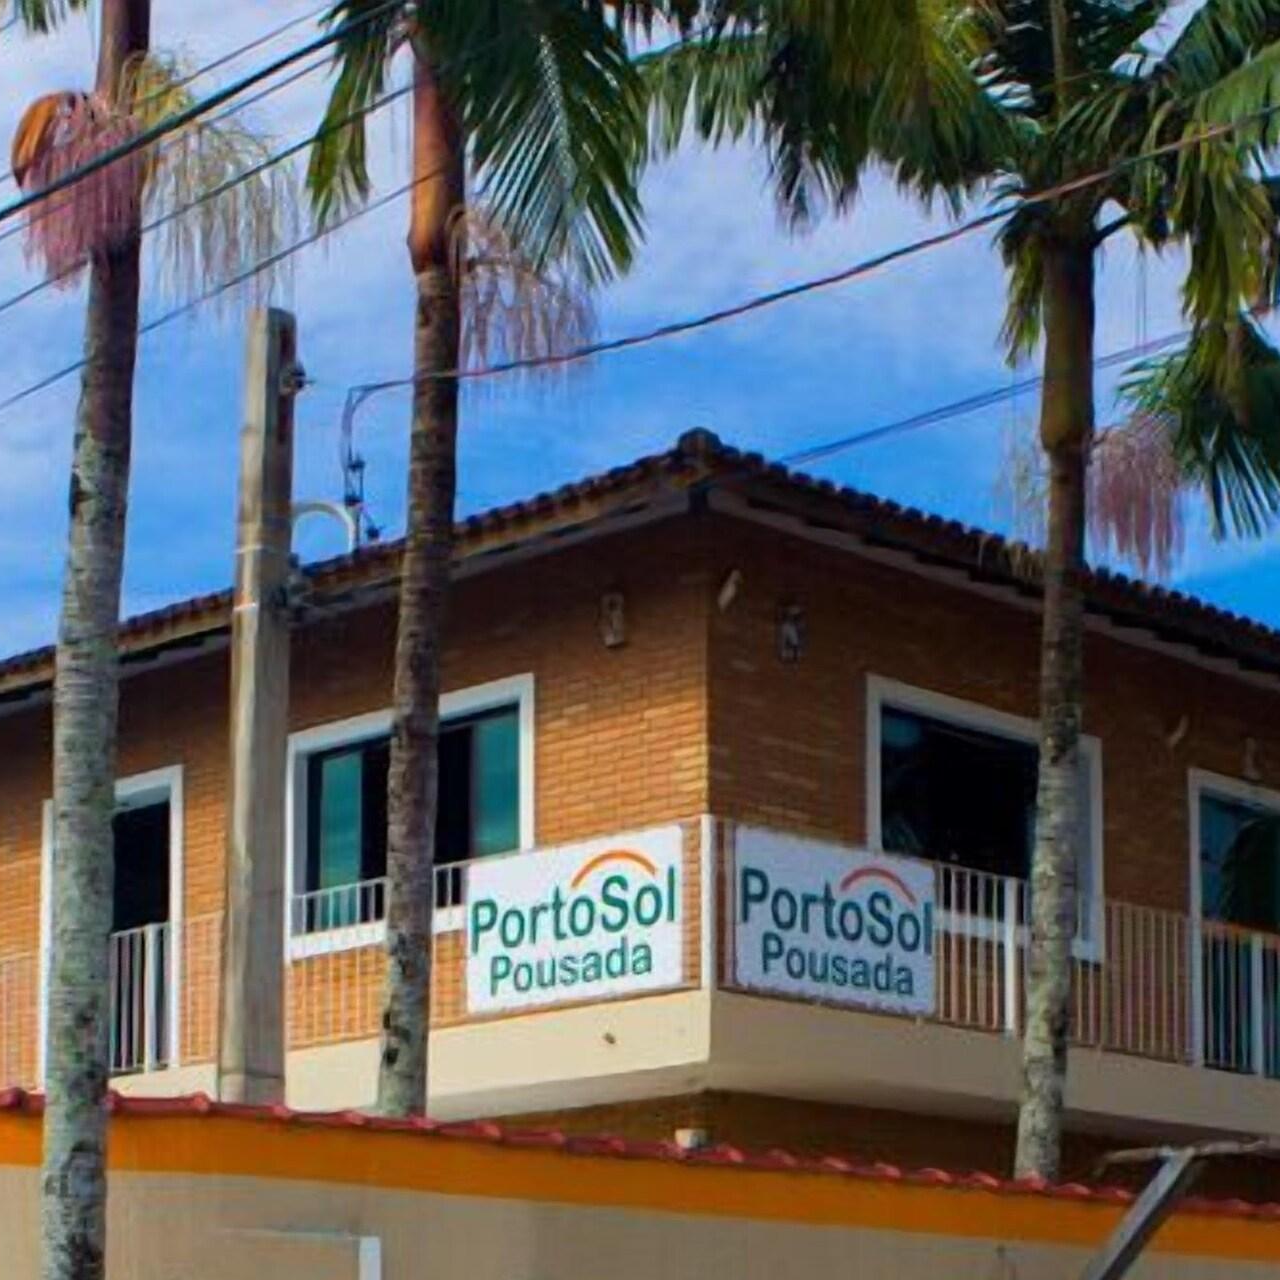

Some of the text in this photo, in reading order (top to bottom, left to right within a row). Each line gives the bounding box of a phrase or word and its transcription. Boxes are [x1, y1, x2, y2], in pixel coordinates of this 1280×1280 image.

[470, 866, 676, 954] PortoSol
[741, 866, 933, 955] PortoSol
[489, 938, 653, 996] Pousada
[762, 932, 915, 996] Pousada
